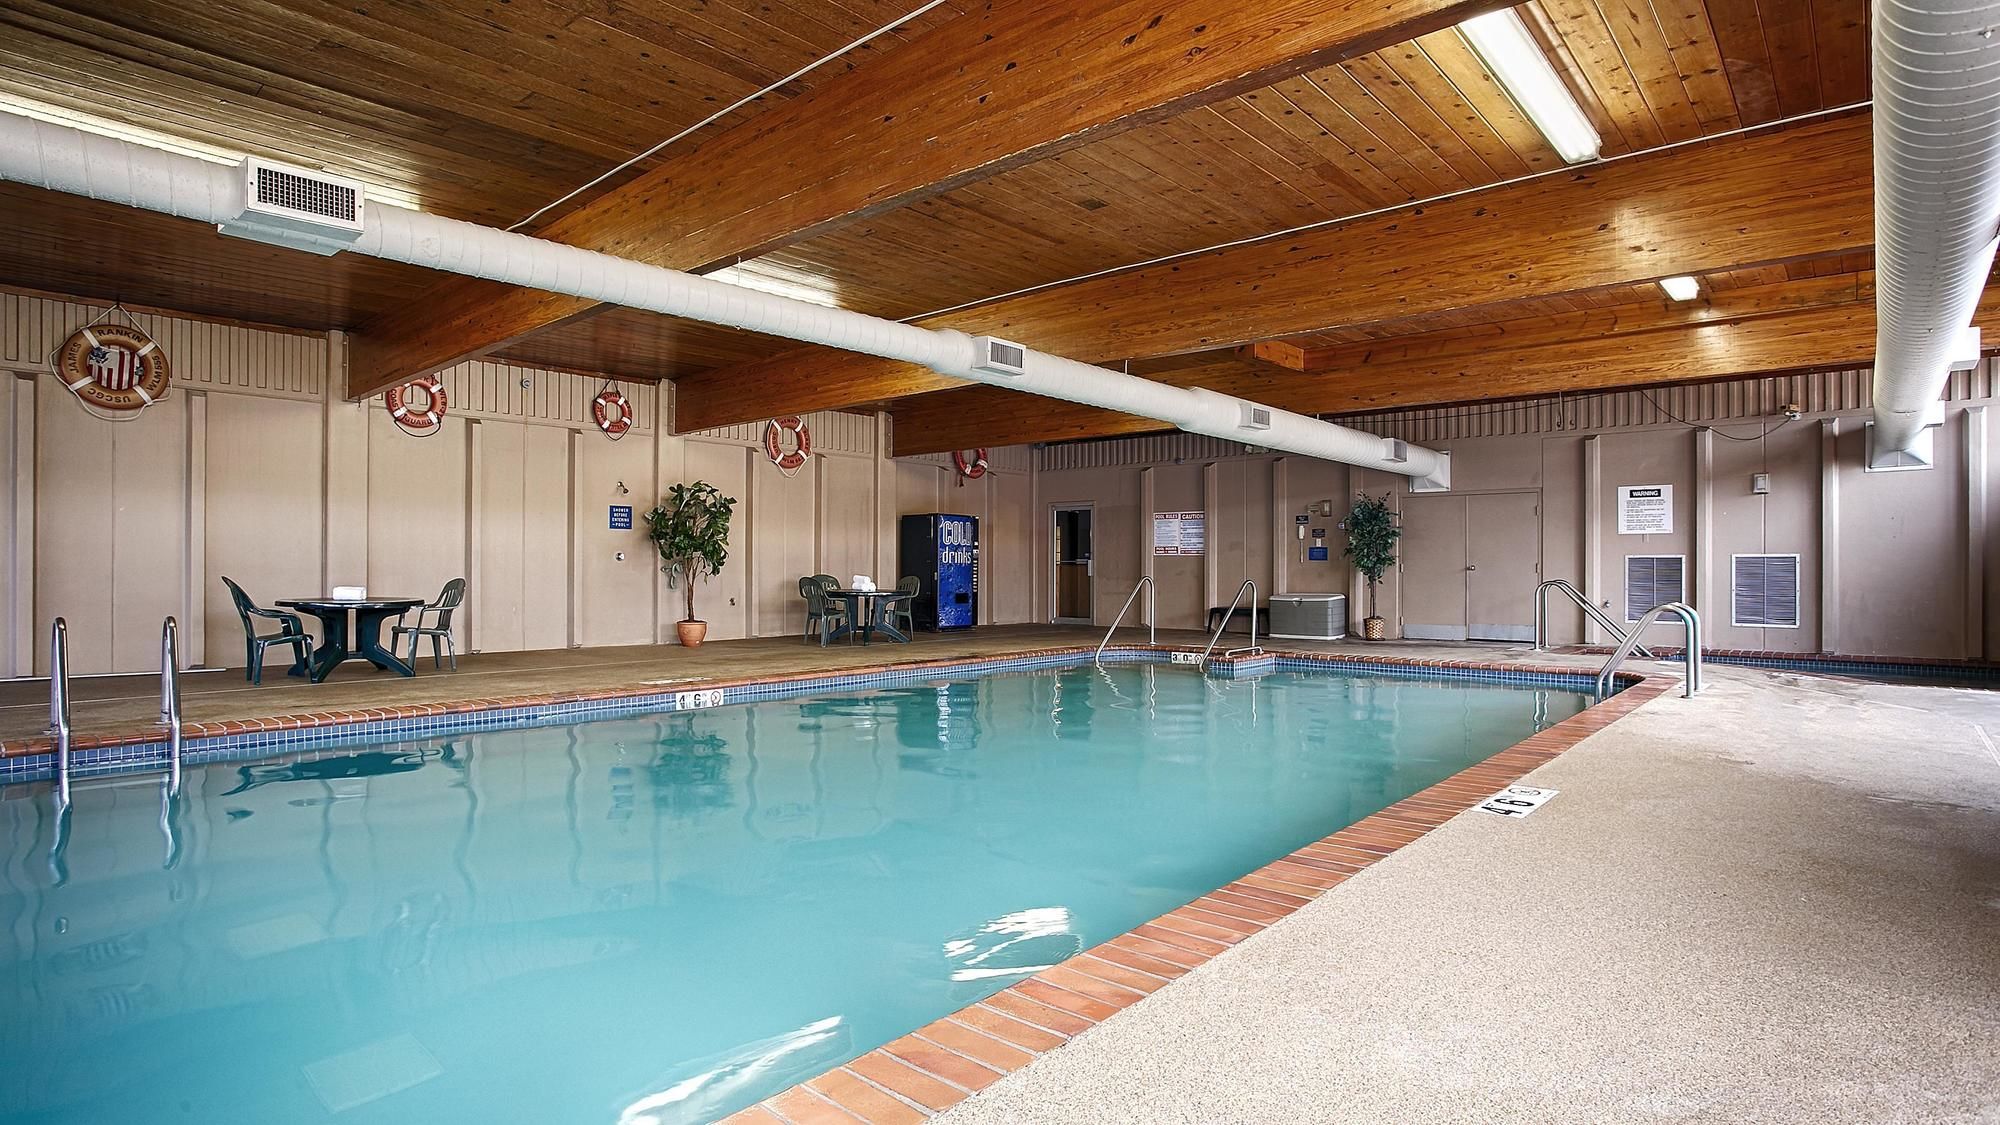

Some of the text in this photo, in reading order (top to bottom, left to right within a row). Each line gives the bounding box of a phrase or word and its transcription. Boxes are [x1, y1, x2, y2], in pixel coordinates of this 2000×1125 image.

[96, 328, 144, 343] RANKIN
[68, 342, 82, 373] JAMES
[87, 388, 131, 403] USCGC
[404, 415, 433, 425] GUARD
[942, 521, 972, 545] COLD
[942, 546, 972, 565] drinks
